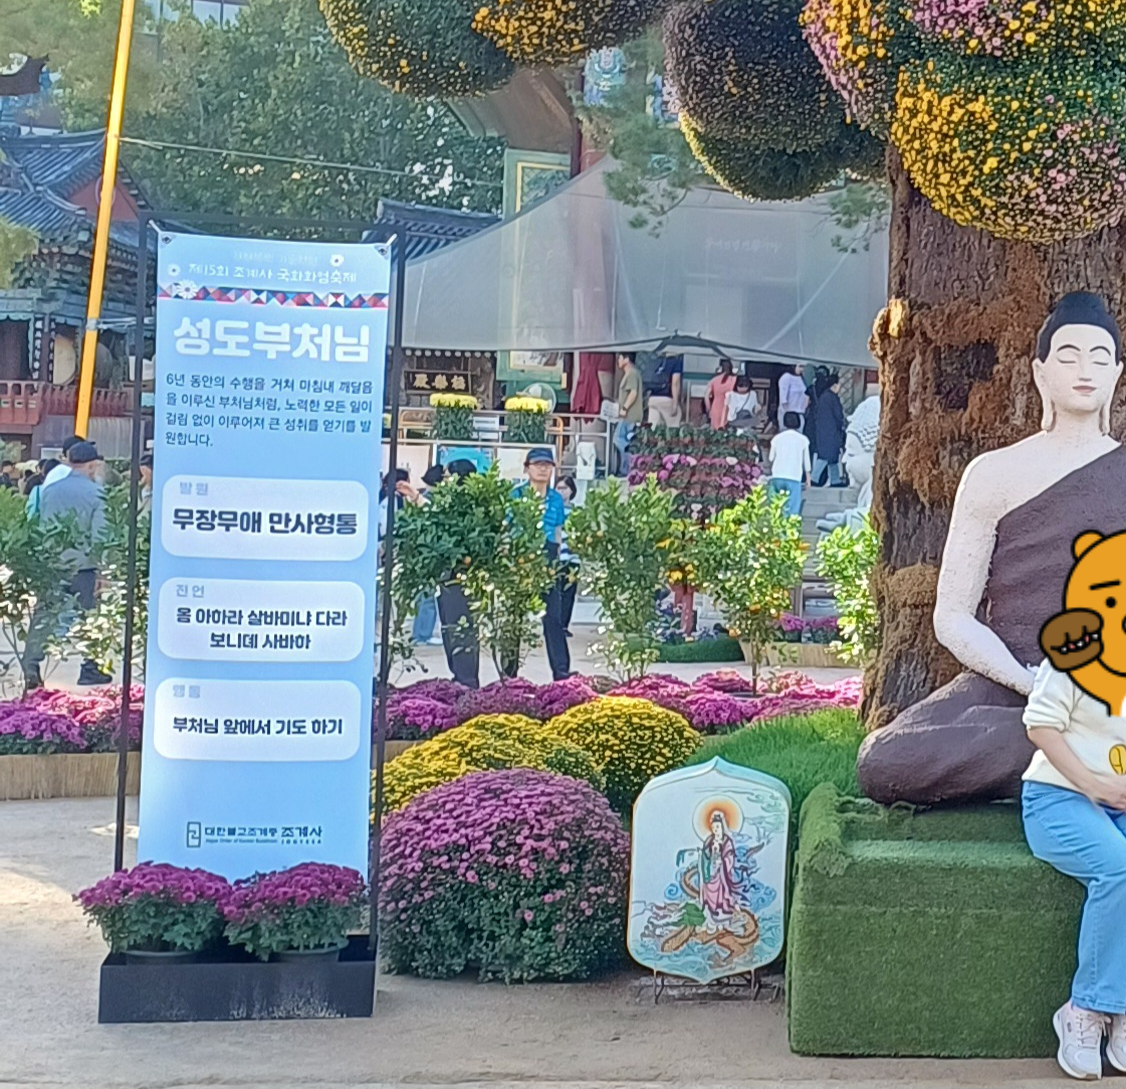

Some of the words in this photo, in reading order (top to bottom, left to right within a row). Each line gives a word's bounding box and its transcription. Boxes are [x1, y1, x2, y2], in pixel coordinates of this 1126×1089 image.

[188, 263, 229, 277] 제15회
[233, 266, 273, 280] 조계사
[173, 316, 370, 363] 성도부처님
[166, 373, 185, 387] 6년
[190, 374, 225, 389] 동안의
[230, 377, 265, 391] 수행을
[300, 379, 335, 394] 마침내
[339, 381, 373, 395] 깨달음
[181, 394, 215, 408] 이루신
[219, 395, 281, 412] 부처님처럼,
[284, 398, 320, 413] 노력한
[323, 400, 346, 414] 모든
[350, 400, 372, 414] 일이
[166, 412, 188, 426] 걸림
[192, 414, 215, 428] 없이
[268, 417, 280, 430] 큰
[284, 418, 318, 432] 성취를
[323, 419, 356, 433] 얻기를
[165, 431, 213, 447] 원합니다.
[172, 508, 262, 533] 무장무애
[268, 512, 358, 535] 만사형통
[195, 609, 244, 625] 아하라
[315, 611, 348, 626] 다라
[261, 634, 311, 649] 사바하
[172, 717, 219, 734] 부처님
[223, 719, 271, 735] 앞에서
[275, 719, 307, 735] 기도
[311, 719, 343, 735] 하기
[281, 826, 322, 837] 조계사
